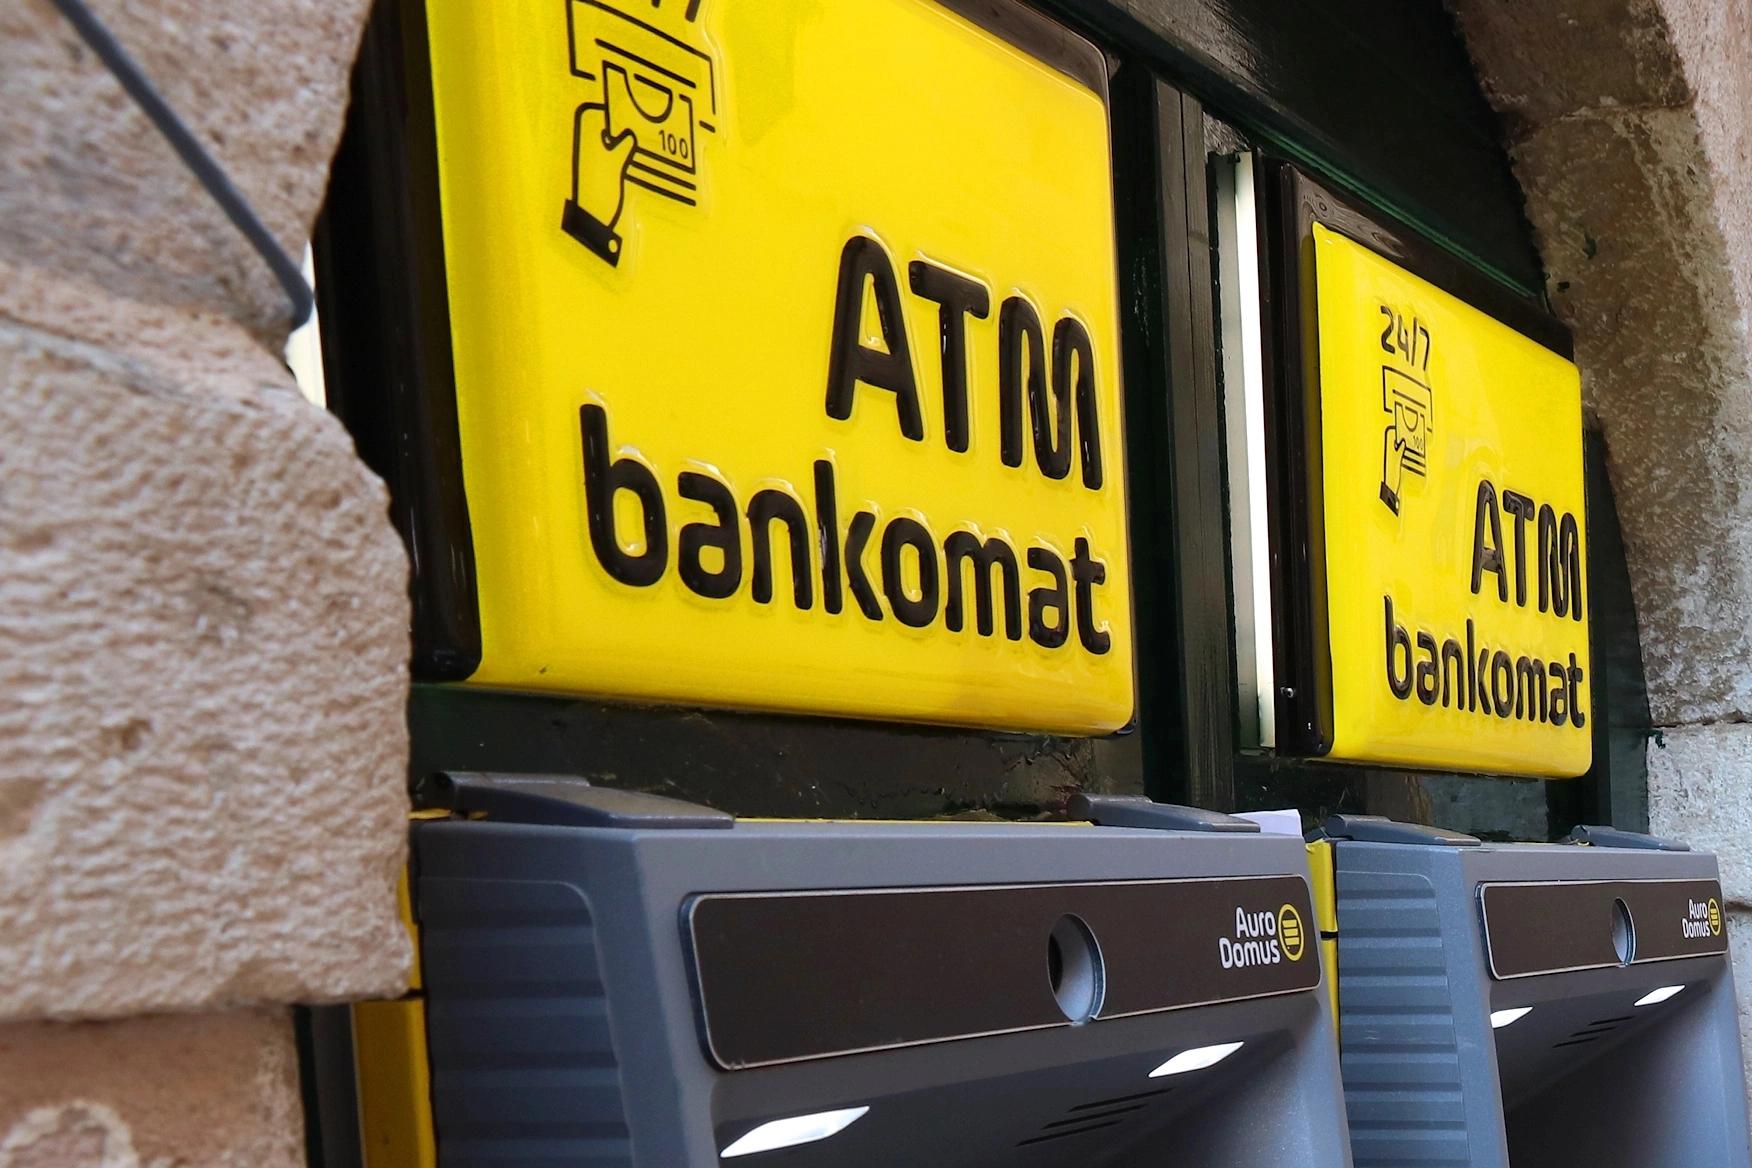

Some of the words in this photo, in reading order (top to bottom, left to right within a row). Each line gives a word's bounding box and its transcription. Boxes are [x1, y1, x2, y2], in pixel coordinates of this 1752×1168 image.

[658, 129, 689, 160] 100
[825, 235, 1104, 491] ATM
[1380, 305, 1430, 372] 24/7
[579, 402, 1111, 656] bankomat
[1470, 479, 1582, 622] ATM
[1384, 594, 1586, 728] bankomat
[1235, 906, 1277, 938] Auro
[1681, 918, 1711, 938] Domus
[1688, 898, 1708, 919] Auro
[1219, 937, 1281, 969] Domus
